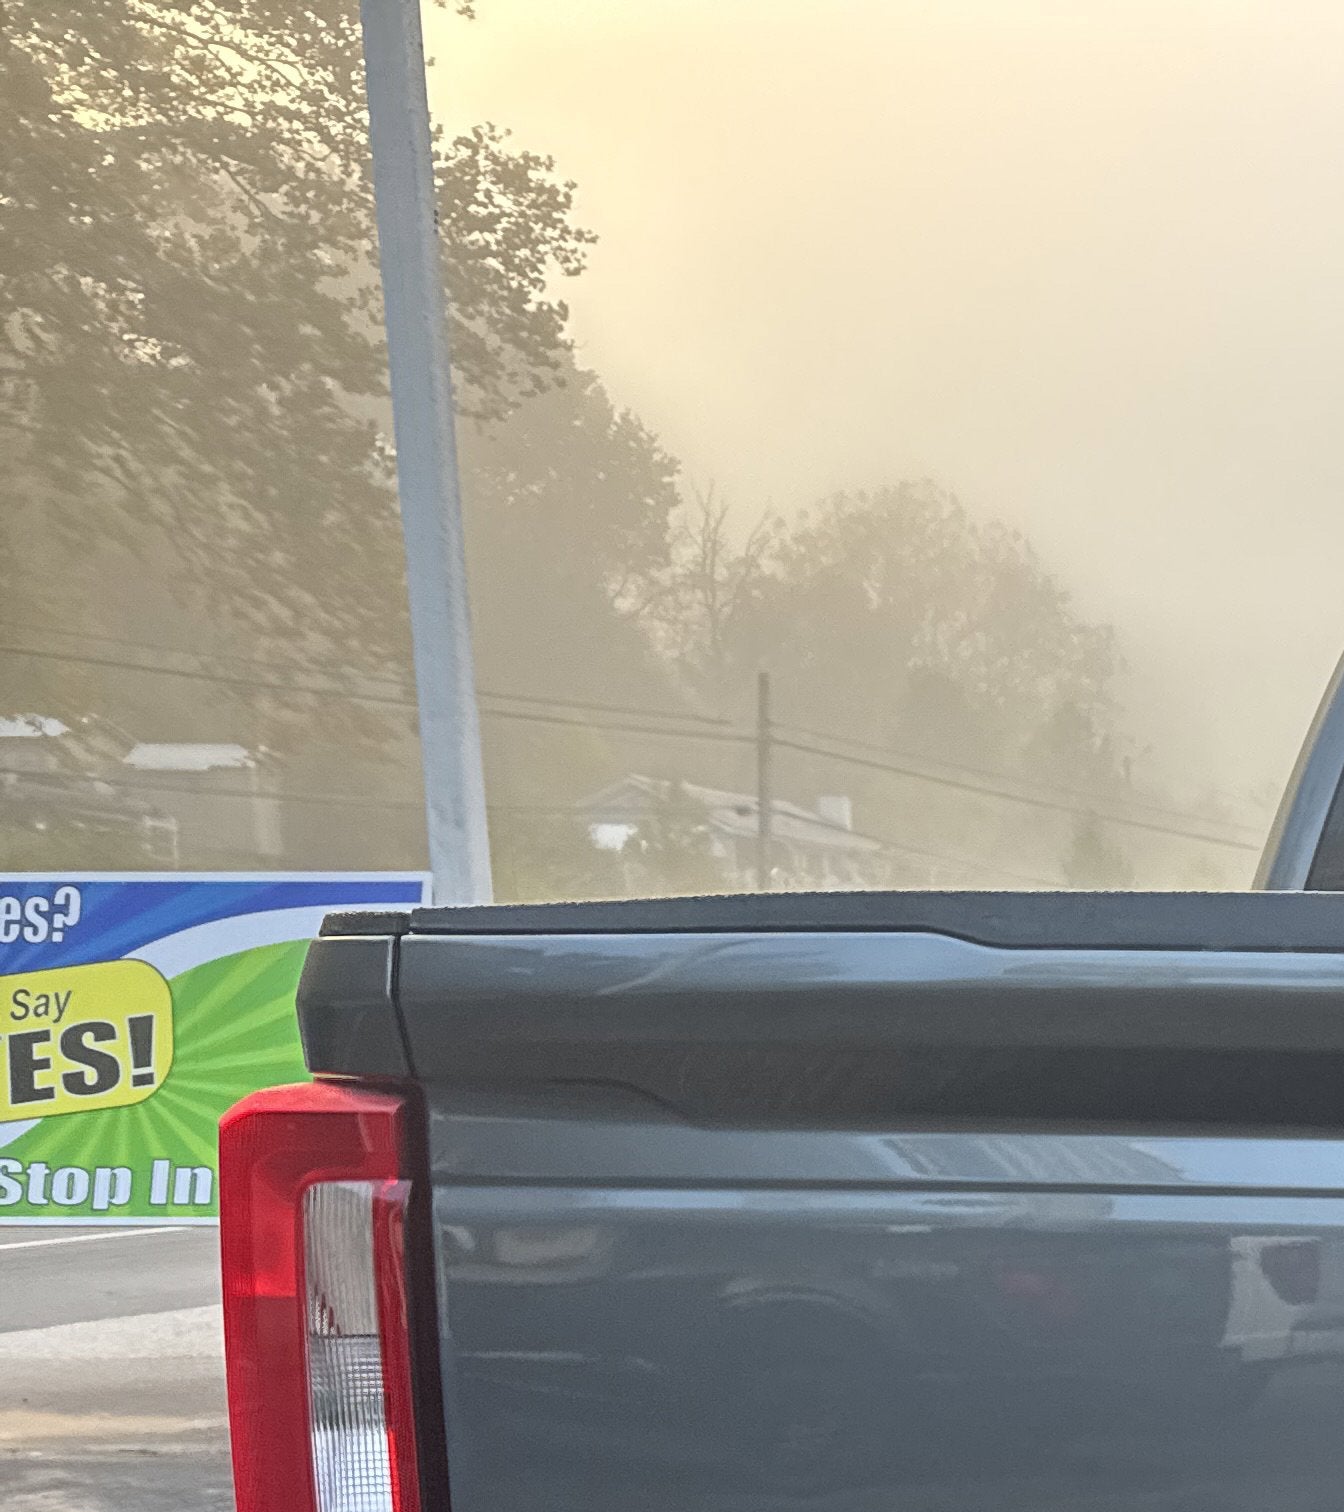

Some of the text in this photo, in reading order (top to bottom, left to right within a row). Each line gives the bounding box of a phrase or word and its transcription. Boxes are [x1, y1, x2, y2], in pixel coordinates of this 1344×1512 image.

[9, 988, 72, 1024] Say
[0, 1014, 156, 1105] ES!
[0, 1157, 214, 1211] Stop In
